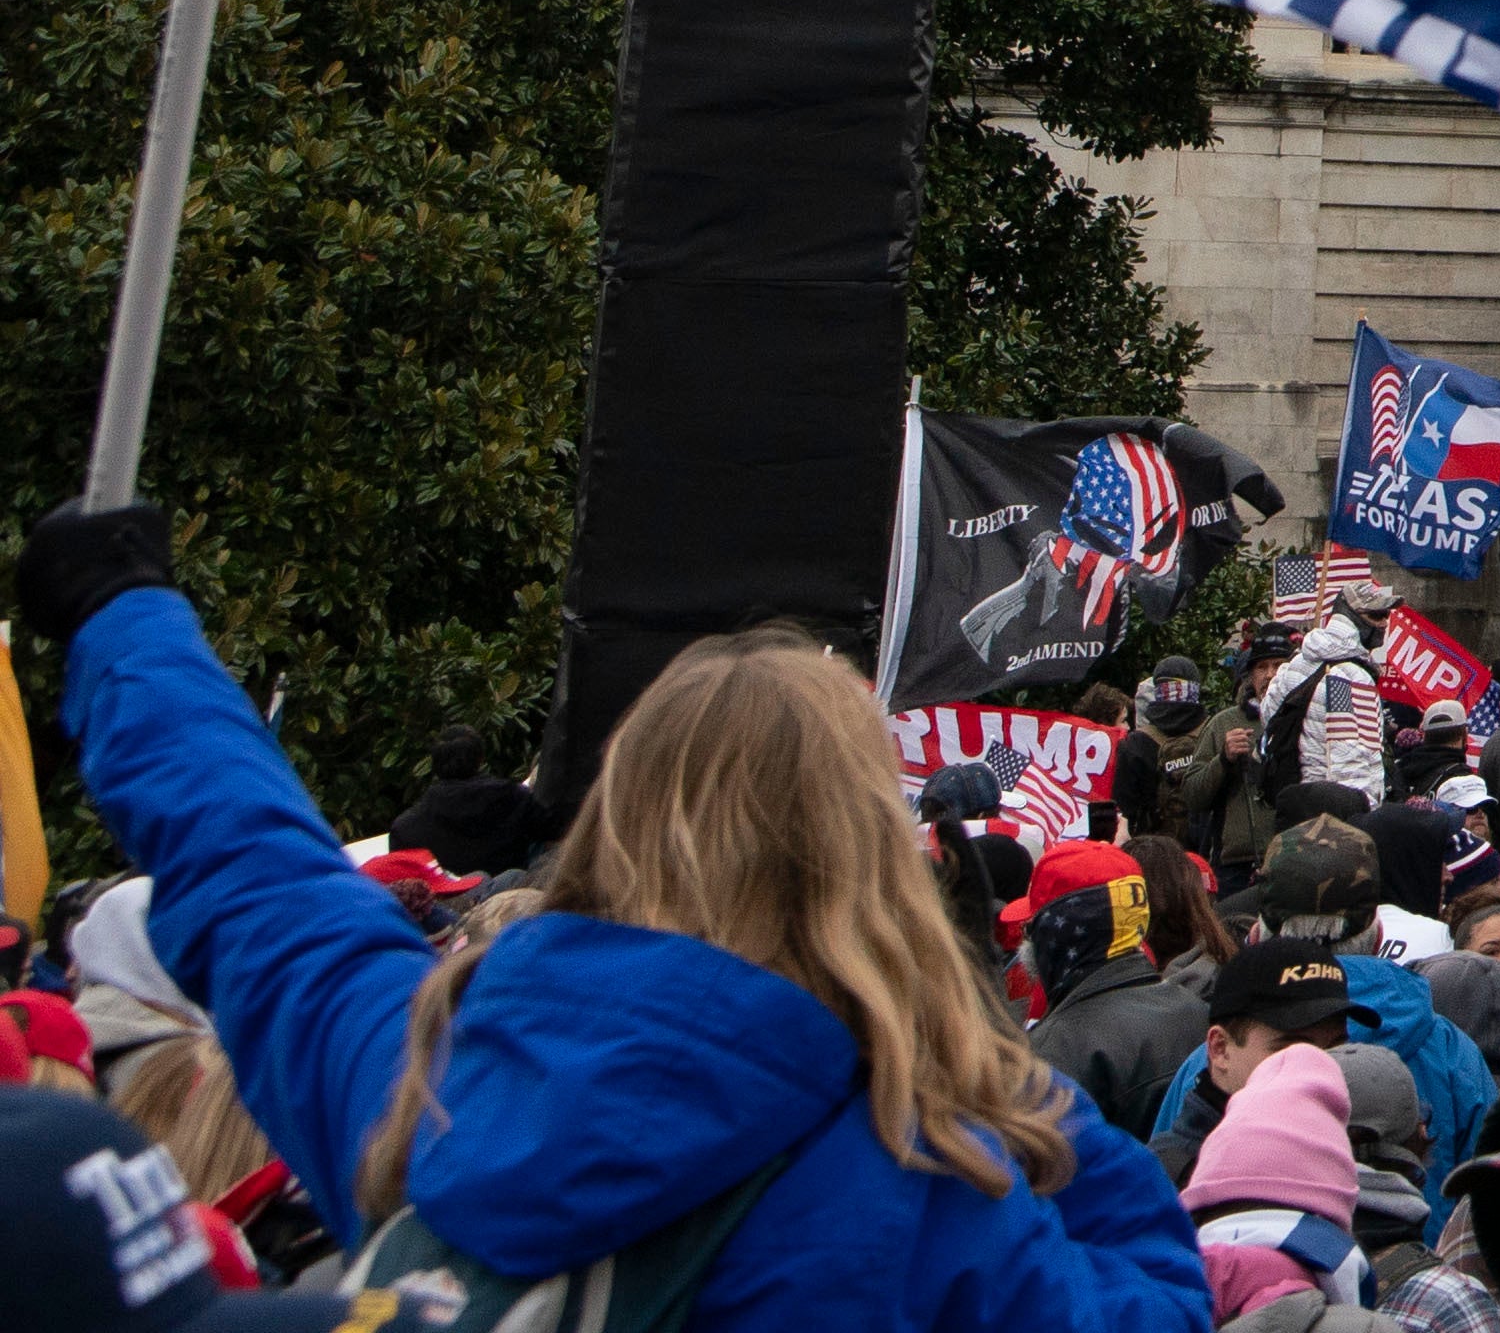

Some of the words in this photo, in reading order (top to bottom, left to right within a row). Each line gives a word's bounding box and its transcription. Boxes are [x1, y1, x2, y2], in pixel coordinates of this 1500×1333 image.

[947, 503, 1040, 540] LIBERTY
[1356, 502, 1395, 535] FOR
[1005, 647, 1034, 673] 2nd
[1279, 962, 1344, 986] KAHR
